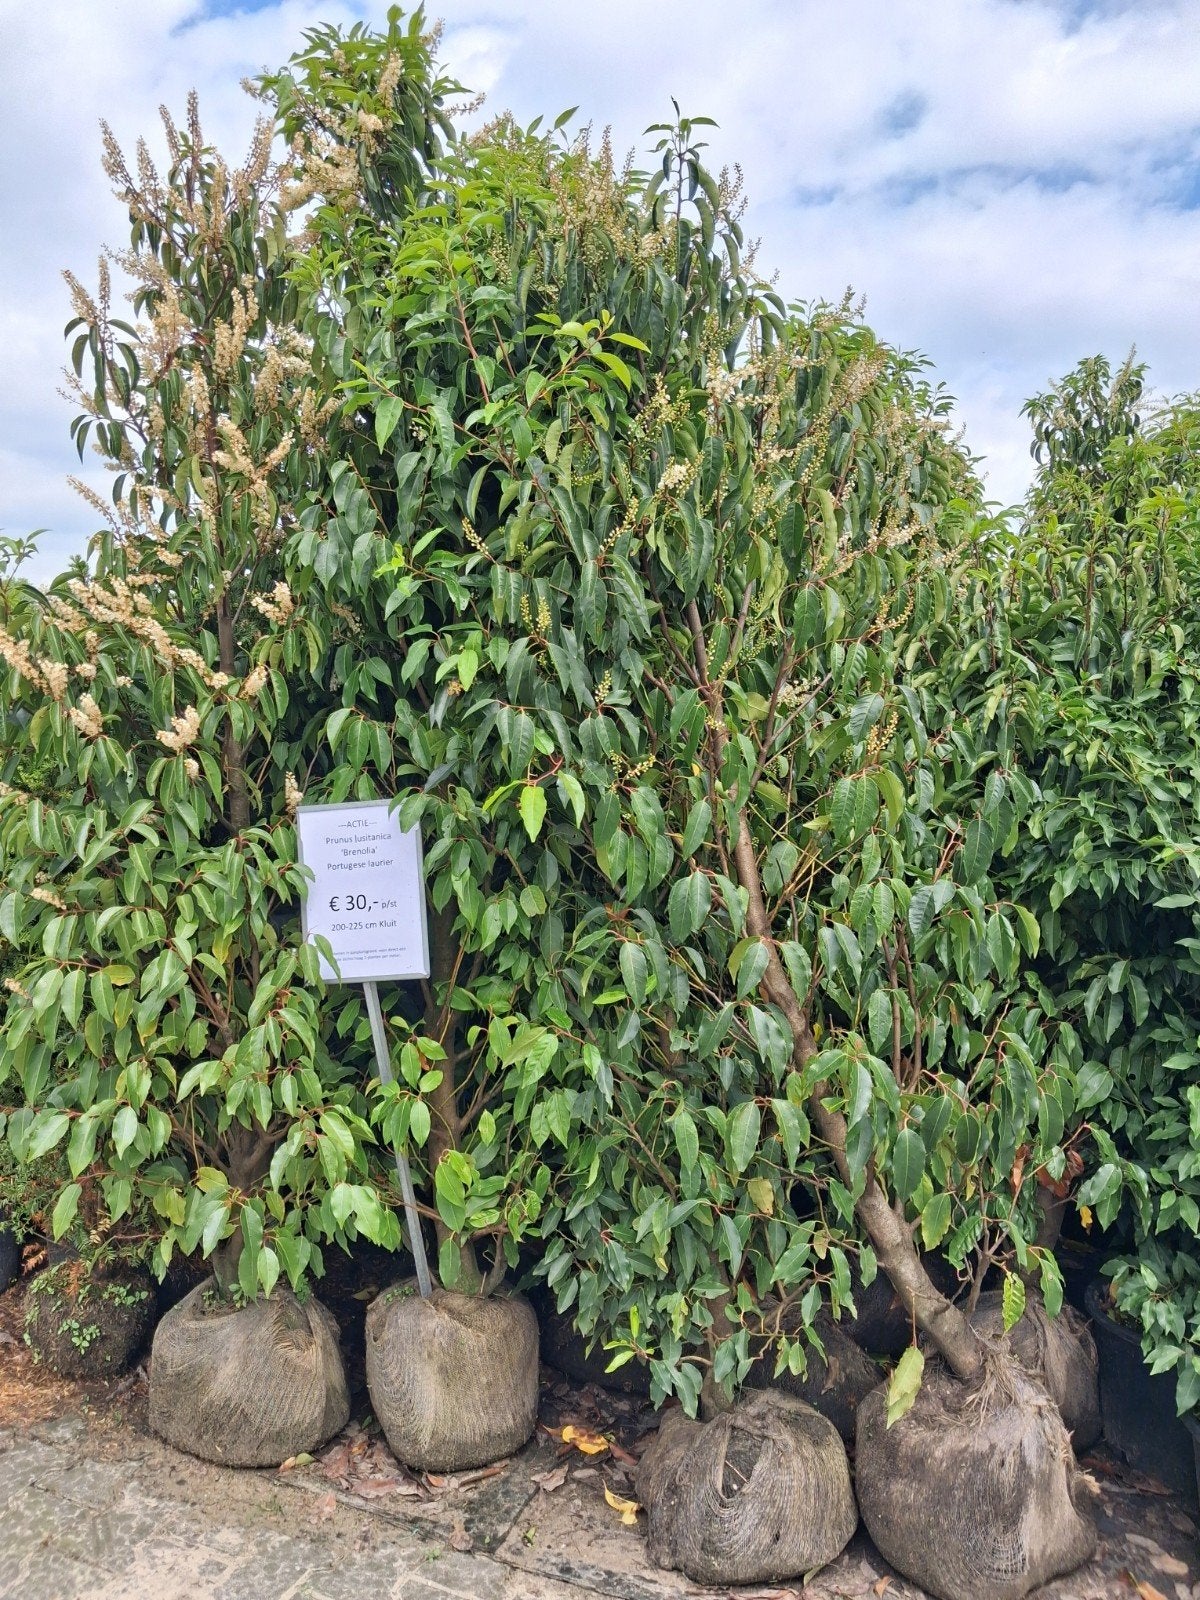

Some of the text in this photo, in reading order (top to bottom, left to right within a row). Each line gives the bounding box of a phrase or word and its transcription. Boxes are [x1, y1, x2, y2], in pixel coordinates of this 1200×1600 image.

[326, 833, 392, 845] Prunus lusitanica
[327, 859, 394, 871] Portugese laurier
[329, 894, 398, 912] € 30,- p/st
[331, 921, 363, 932] 200-225
[379, 920, 398, 929] Kluit
